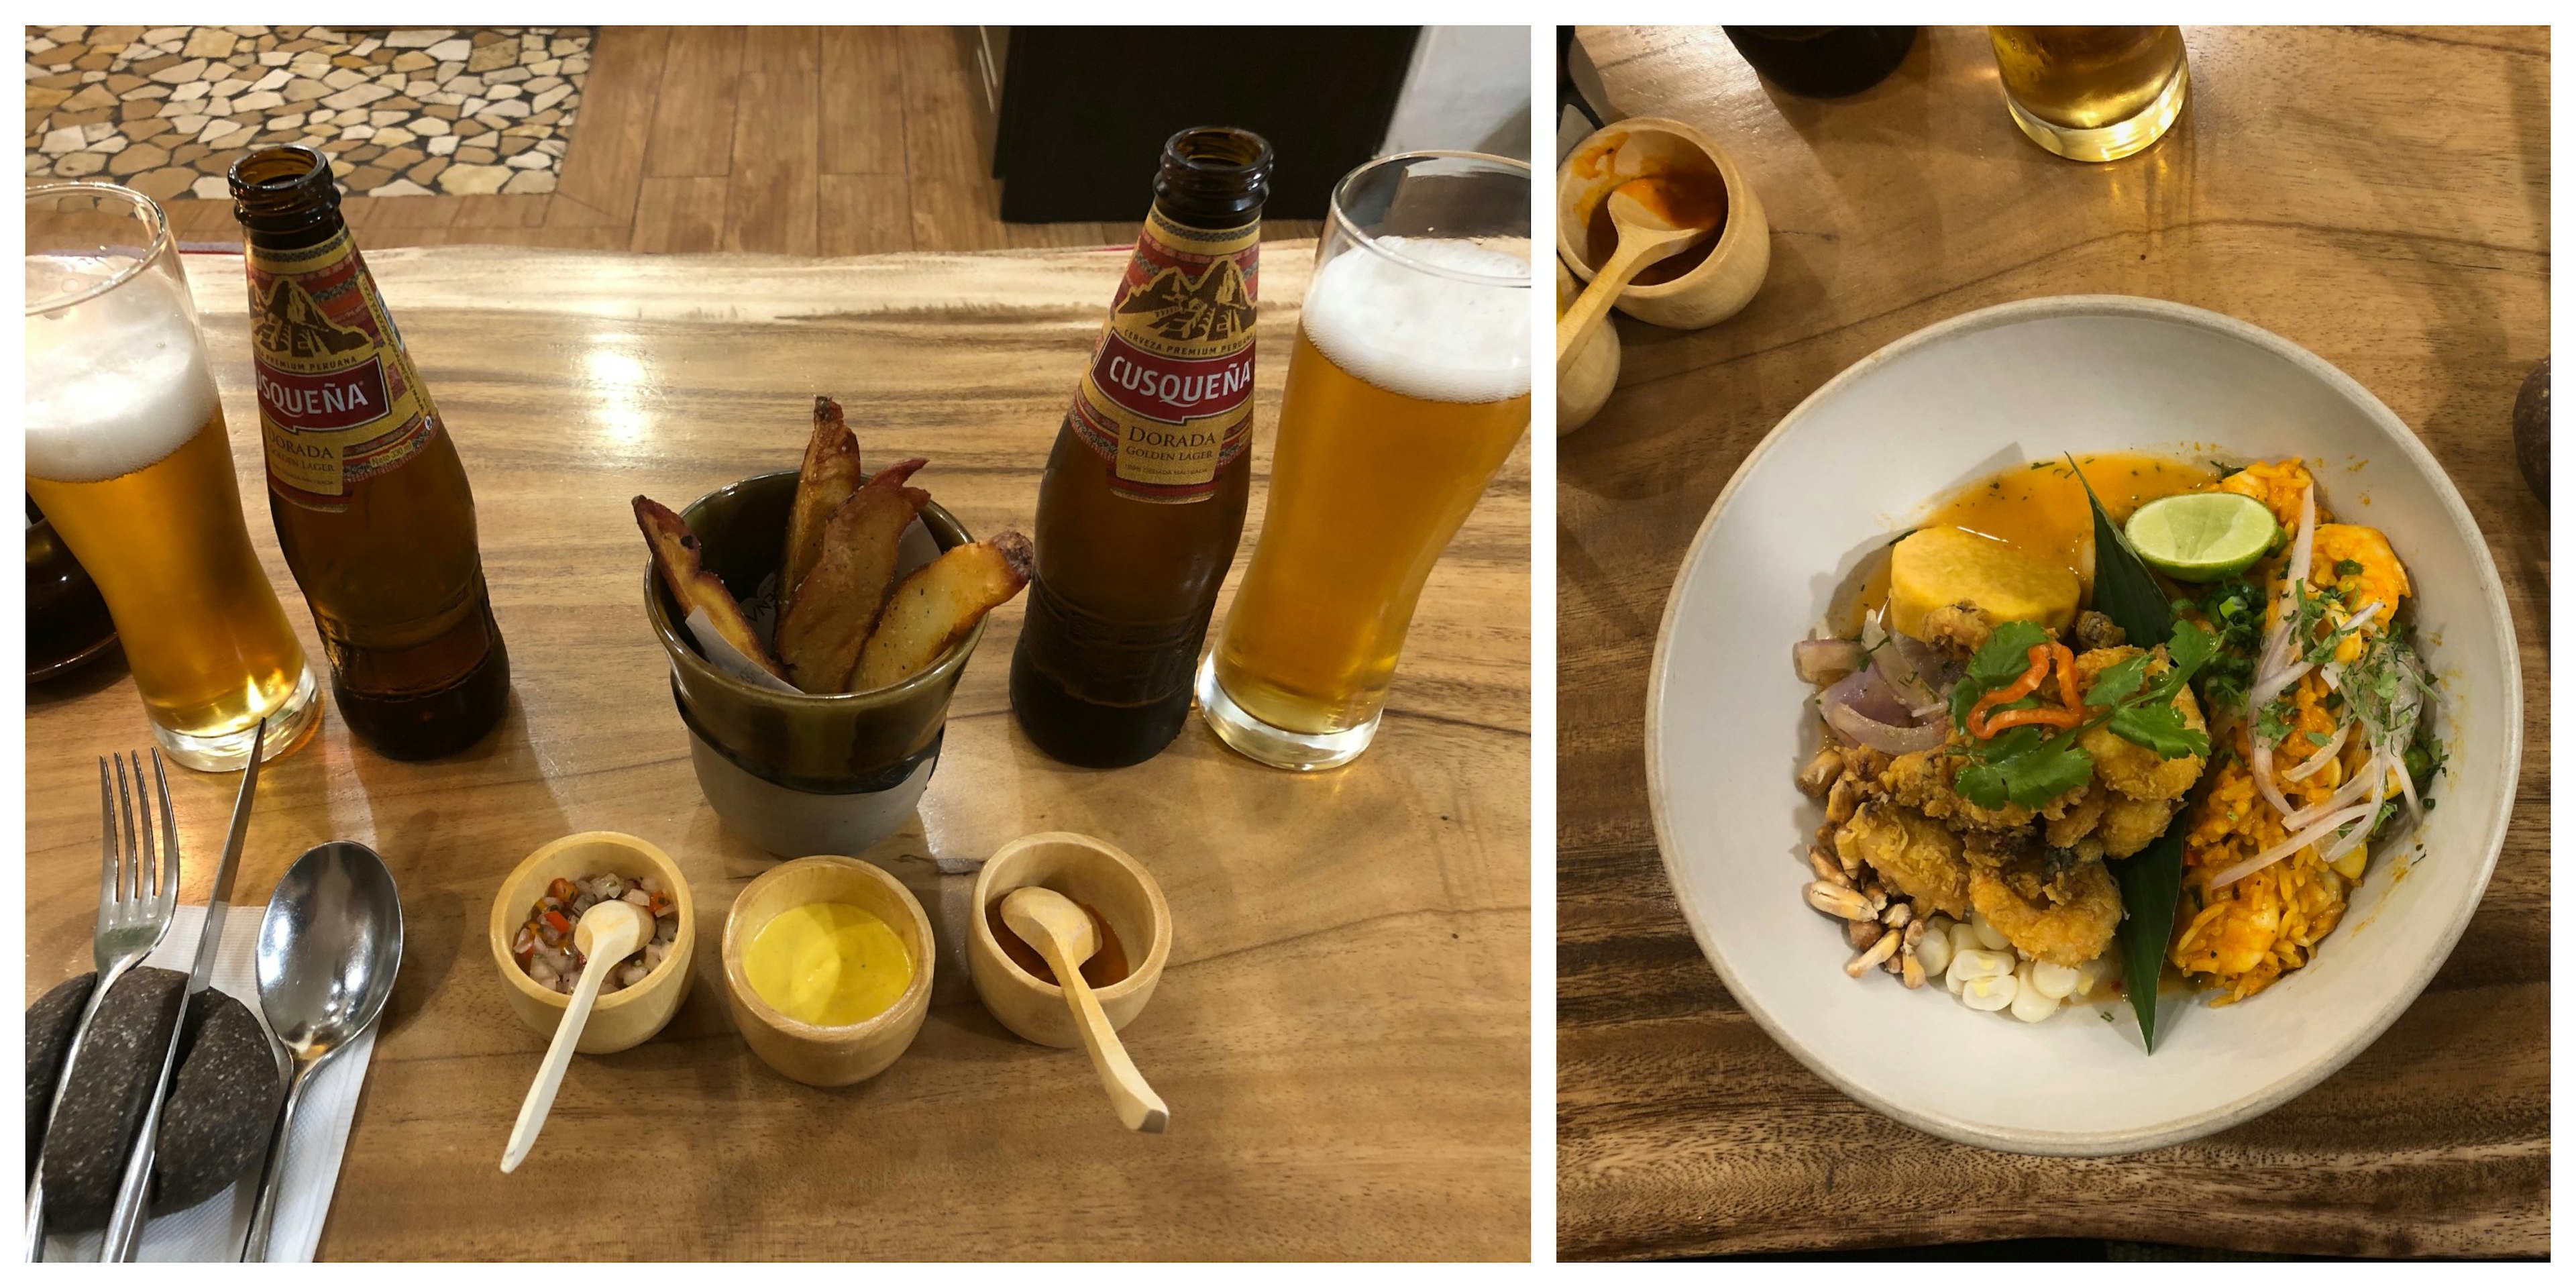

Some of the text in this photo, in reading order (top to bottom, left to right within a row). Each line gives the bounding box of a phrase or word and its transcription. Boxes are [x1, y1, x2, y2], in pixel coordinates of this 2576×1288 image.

[1124, 329, 1162, 352] CERVEZA
[1167, 345, 1217, 356] PREMIUM
[266, 354, 358, 370] PREMIUM PERUANA
[1110, 356, 1250, 408] CUSQUEÑA
[1128, 426, 1216, 447] DORADA
[372, 454, 391, 467] Neto
[392, 448, 402, 461] 330
[1126, 445, 1212, 461] GOLDEN LAGER
[302, 461, 335, 472] LAGER
